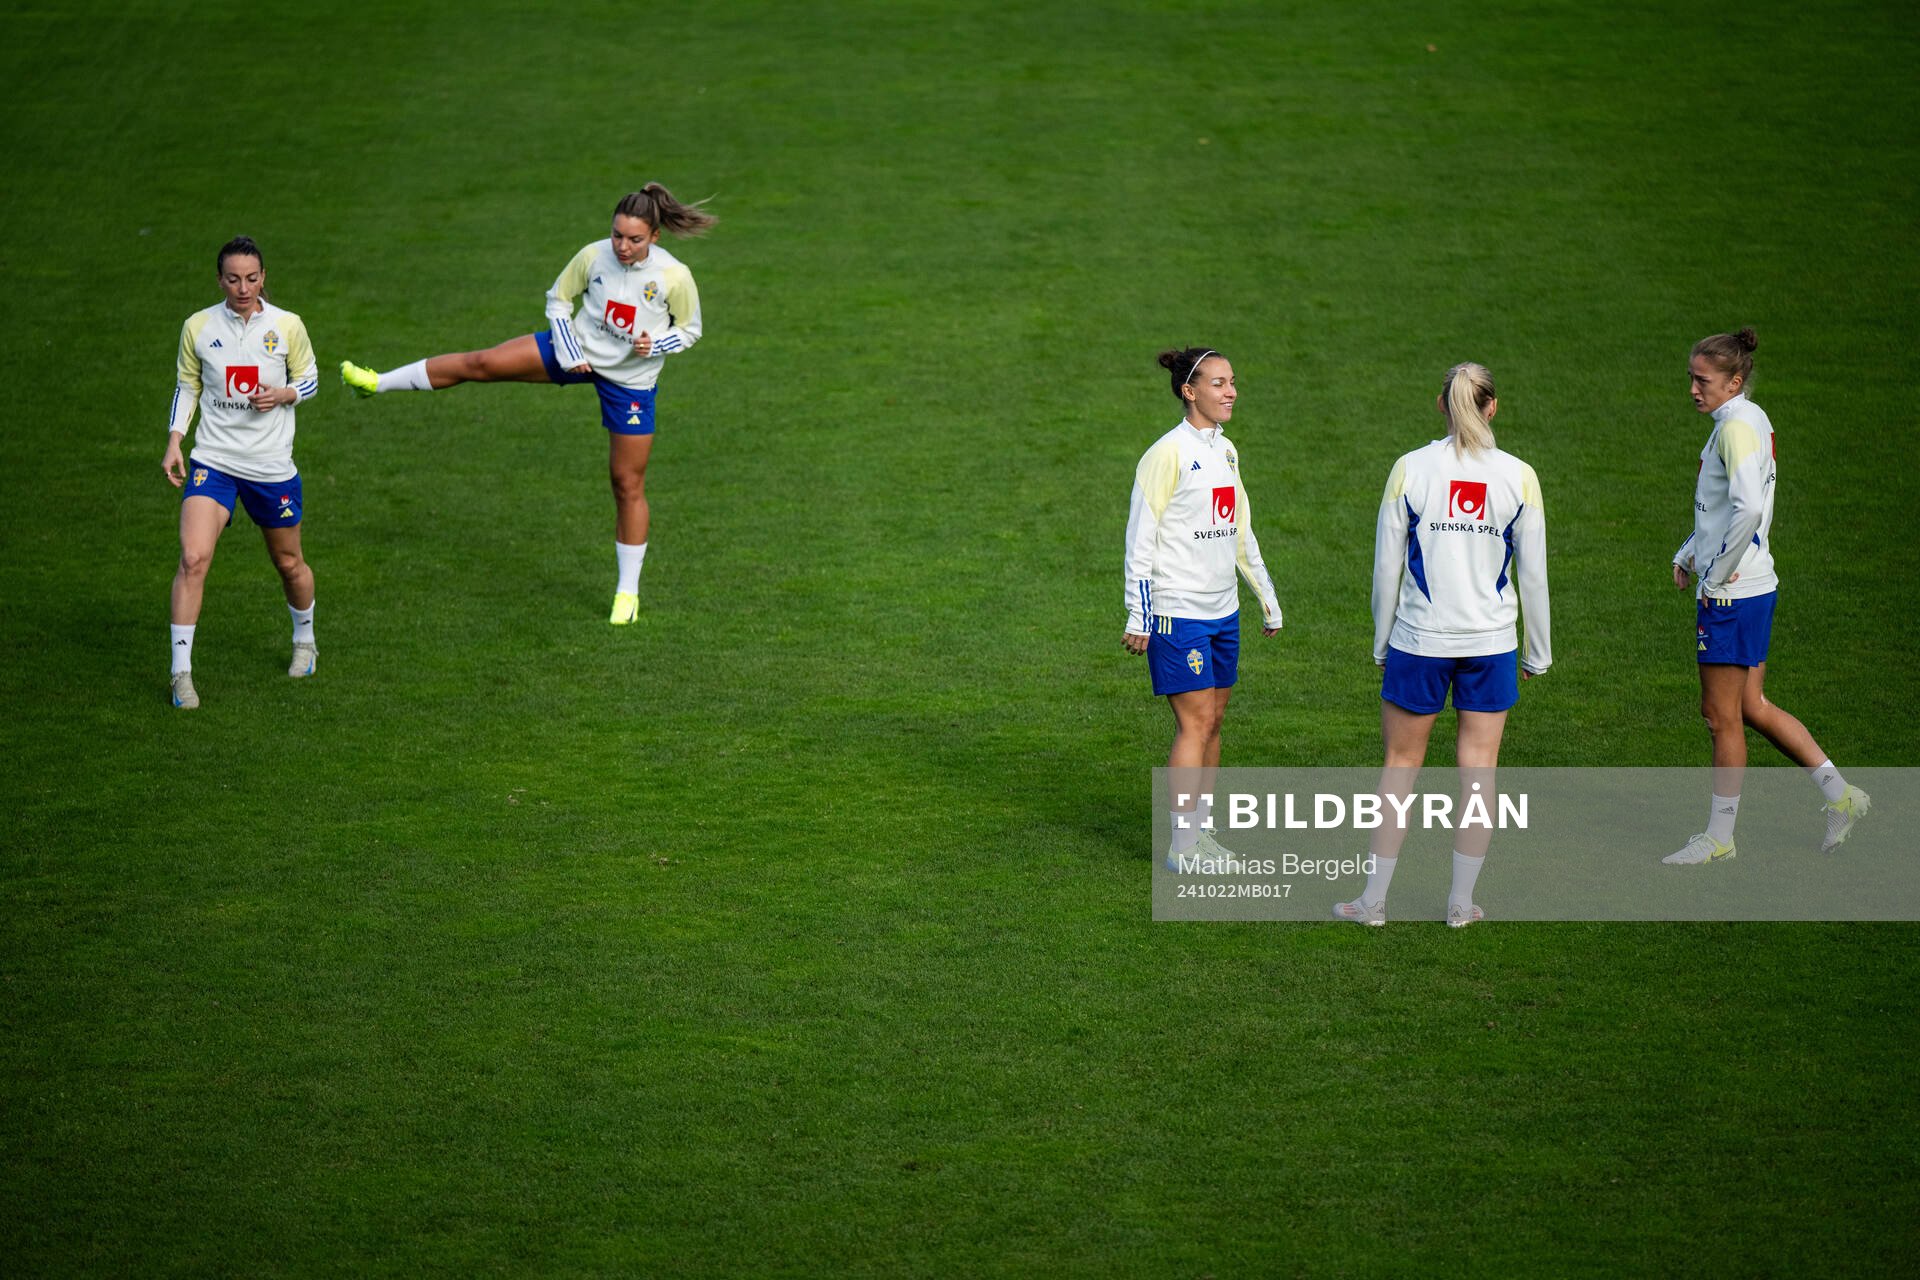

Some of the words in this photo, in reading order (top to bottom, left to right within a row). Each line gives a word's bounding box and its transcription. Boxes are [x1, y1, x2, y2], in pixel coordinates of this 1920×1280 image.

[213, 399, 253, 411] SVENSKA
[1430, 522, 1474, 533] SVENSKA
[1477, 525, 1501, 538] SPEL
